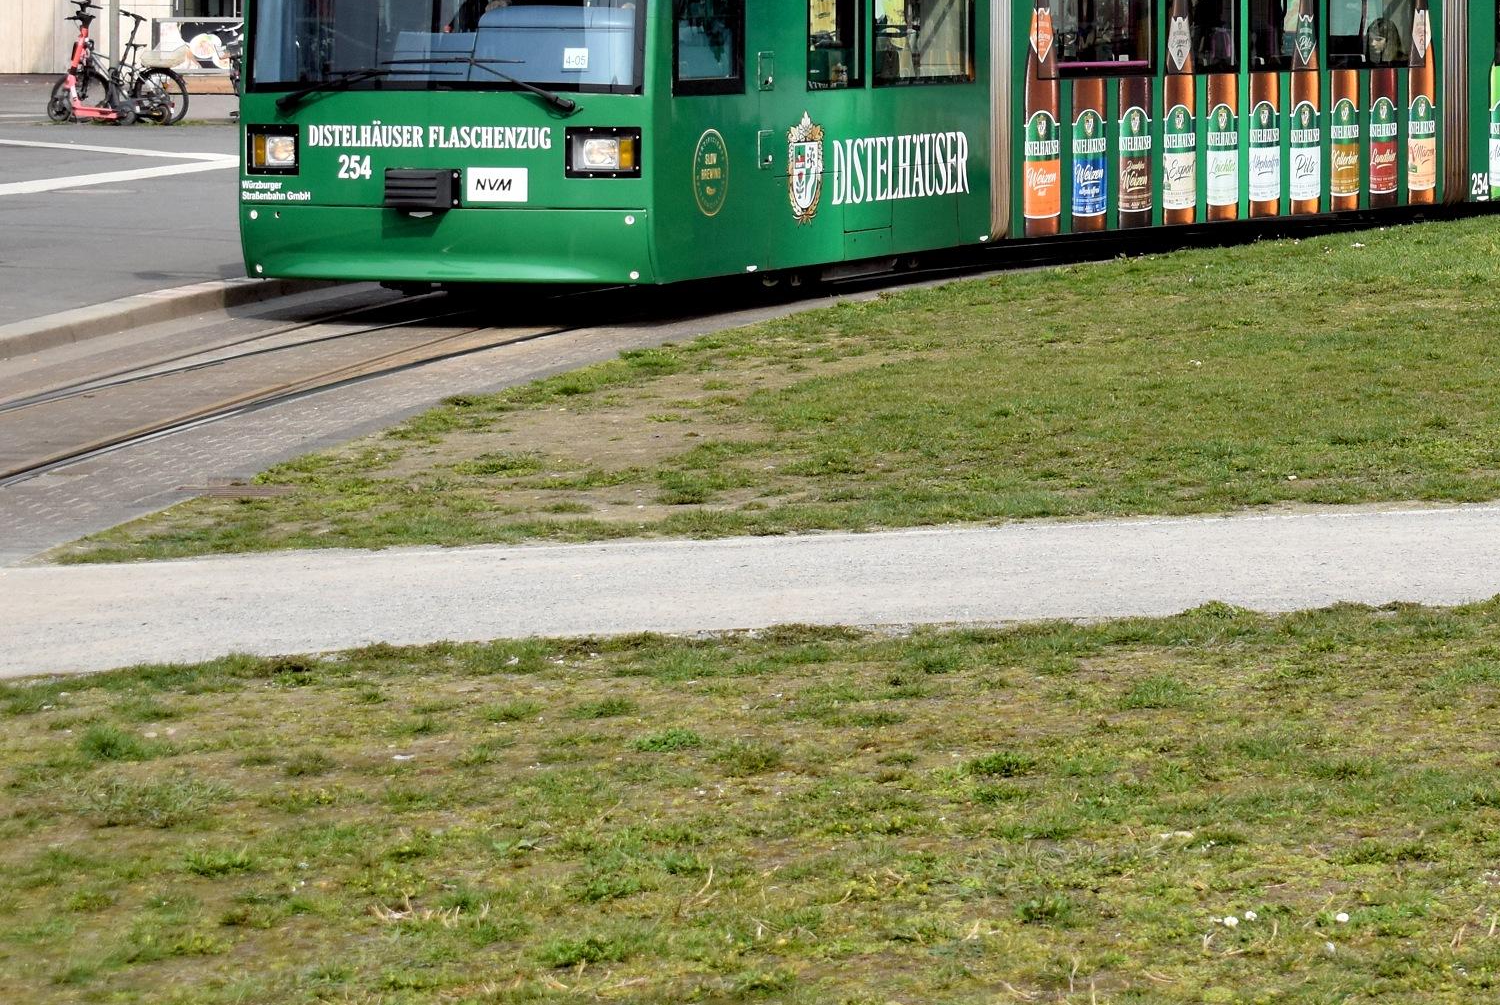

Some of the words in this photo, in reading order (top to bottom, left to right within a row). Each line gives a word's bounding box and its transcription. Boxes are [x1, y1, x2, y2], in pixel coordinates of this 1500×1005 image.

[308, 121, 424, 148] DISTELHÄUSER
[428, 125, 552, 150] FLASCHENZUG
[338, 155, 372, 180] 254
[831, 131, 970, 206] DISTELHÄUSER
[1075, 164, 1104, 184] Weizen
[1295, 154, 1318, 179] Pils
[242, 180, 282, 191] Würzburger
[475, 178, 513, 192] NVM
[1120, 169, 1148, 190] Weizen
[1471, 173, 1489, 195] 254
[242, 190, 286, 202] Straßenbahn
[287, 190, 311, 201] GmbH
